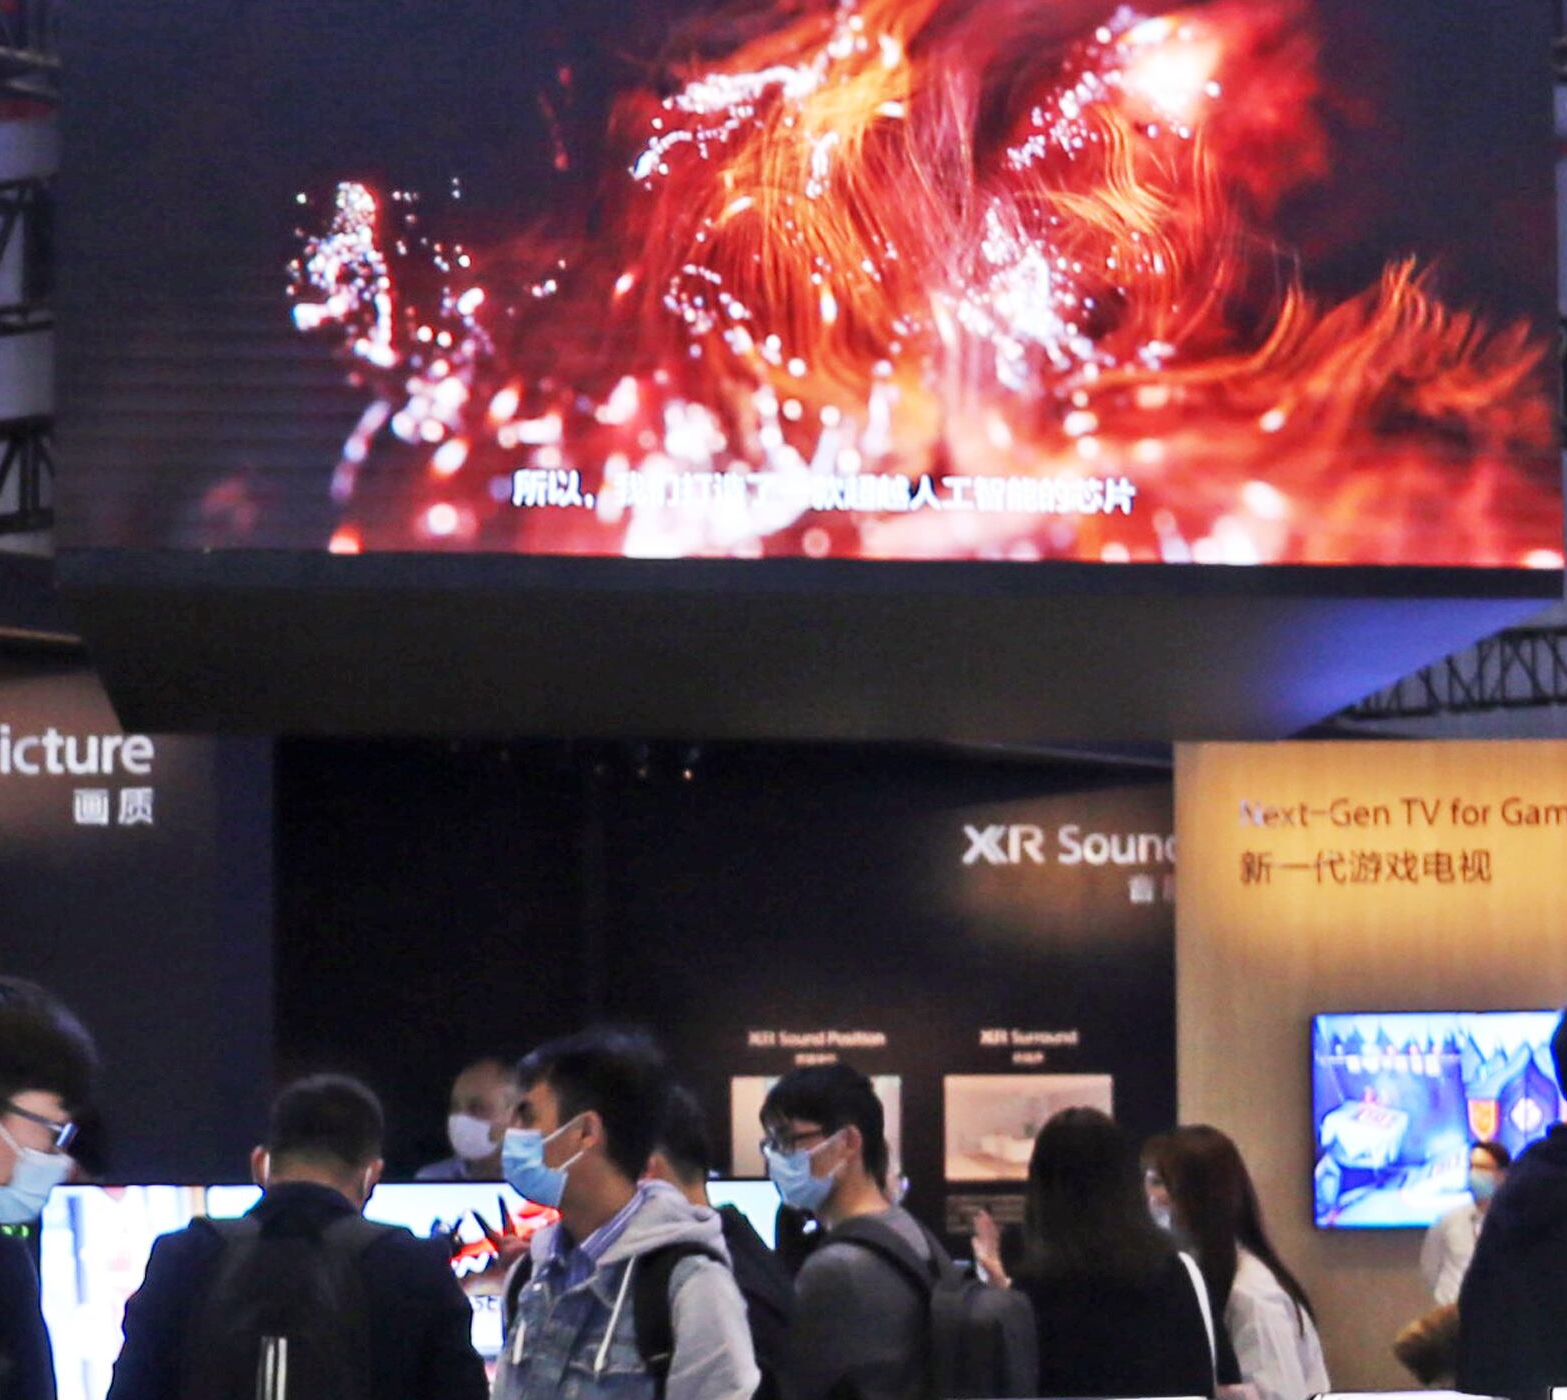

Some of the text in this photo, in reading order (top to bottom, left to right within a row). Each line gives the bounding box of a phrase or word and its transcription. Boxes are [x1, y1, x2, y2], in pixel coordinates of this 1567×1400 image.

[73, 787, 154, 824] 画质
[1239, 799, 1391, 827] Next-Gen
[1401, 799, 1441, 827] TV
[1450, 797, 1491, 827] for
[962, 823, 1046, 865] XR
[1239, 848, 1493, 885] 新一代游戏电视
